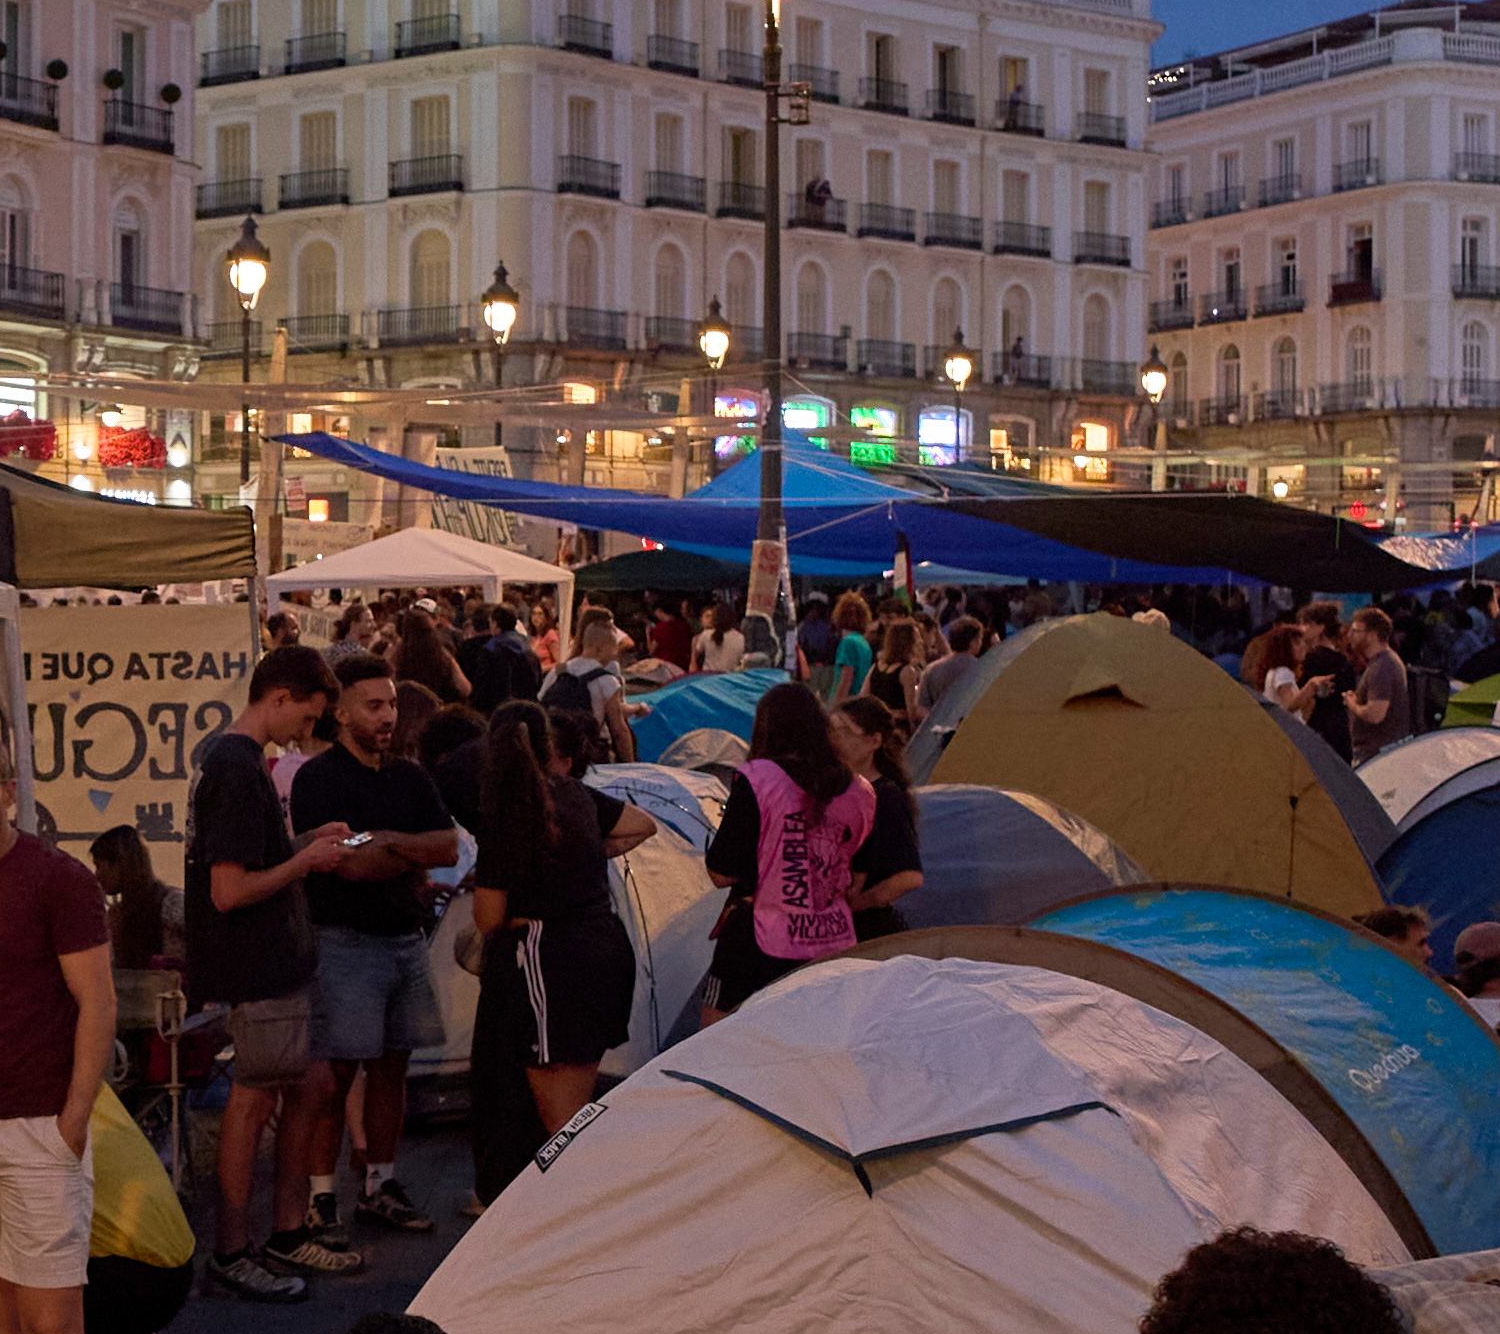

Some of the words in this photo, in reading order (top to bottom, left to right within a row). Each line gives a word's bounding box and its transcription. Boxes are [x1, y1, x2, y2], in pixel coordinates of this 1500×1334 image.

[782, 808, 809, 910] ASAMBLEA
[569, 1104, 598, 1132] FRESH
[539, 1132, 569, 1162] BLACK
